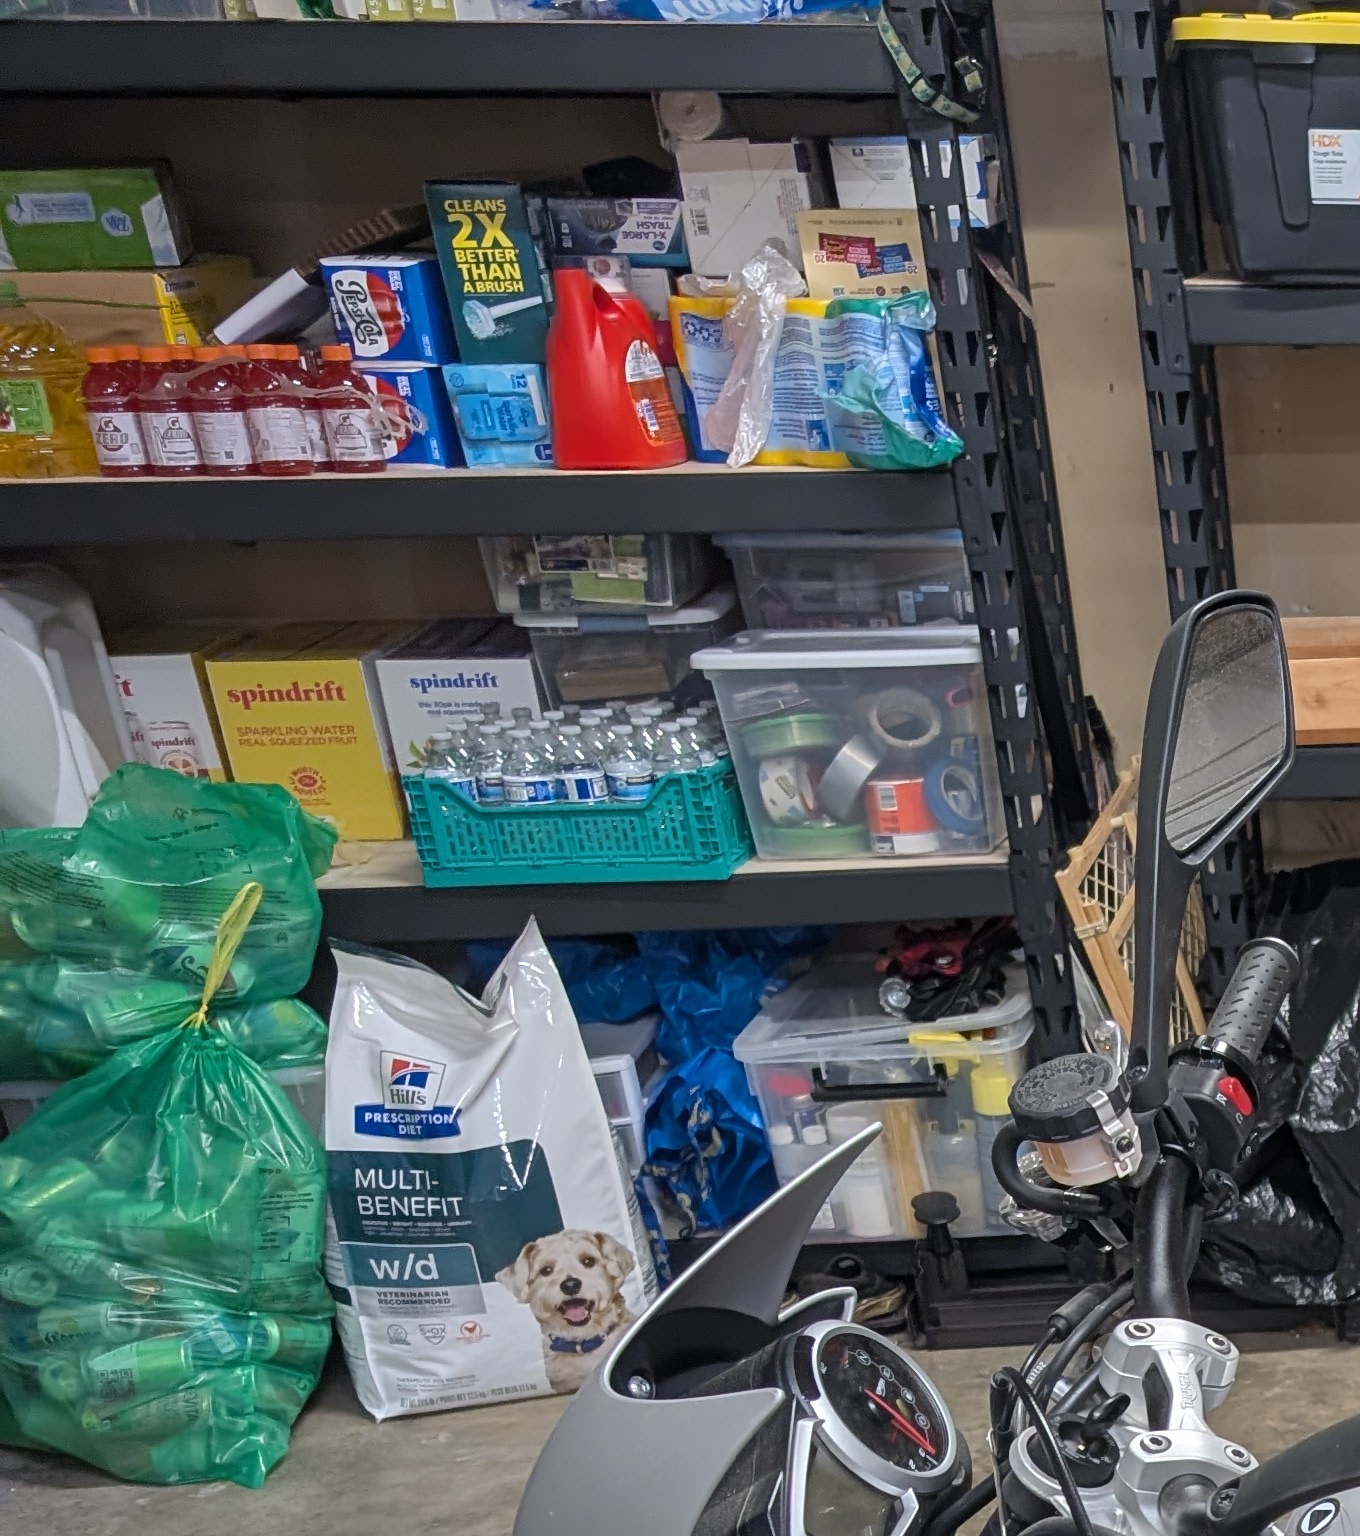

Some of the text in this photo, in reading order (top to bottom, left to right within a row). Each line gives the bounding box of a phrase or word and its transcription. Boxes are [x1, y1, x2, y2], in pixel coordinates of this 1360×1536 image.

[1312, 135, 1342, 148] HDX
[444, 199, 507, 213] CLEANS
[447, 213, 514, 249] 2X
[636, 221, 671, 230] TRASH
[622, 230, 667, 240] X-LARGE
[457, 263, 522, 280] THAN
[463, 281, 524, 293] A BRUSH
[410, 672, 499, 694] spindrift
[227, 680, 346, 710] spindrift
[237, 725, 355, 737] SPARKLING WATER
[152, 736, 195, 749] spindrift
[239, 738, 265, 746] REAL
[269, 736, 326, 746] SQUEEZED
[390, 1088, 427, 1106] Hill's
[364, 1111, 455, 1125] PRESCRIPTION
[398, 1124, 422, 1135] DIET
[355, 1168, 439, 1190] MULTI-
[357, 1196, 463, 1217] BENEFIT
[369, 1253, 439, 1281] w/d
[376, 1290, 449, 1299] VETERINARIAN
